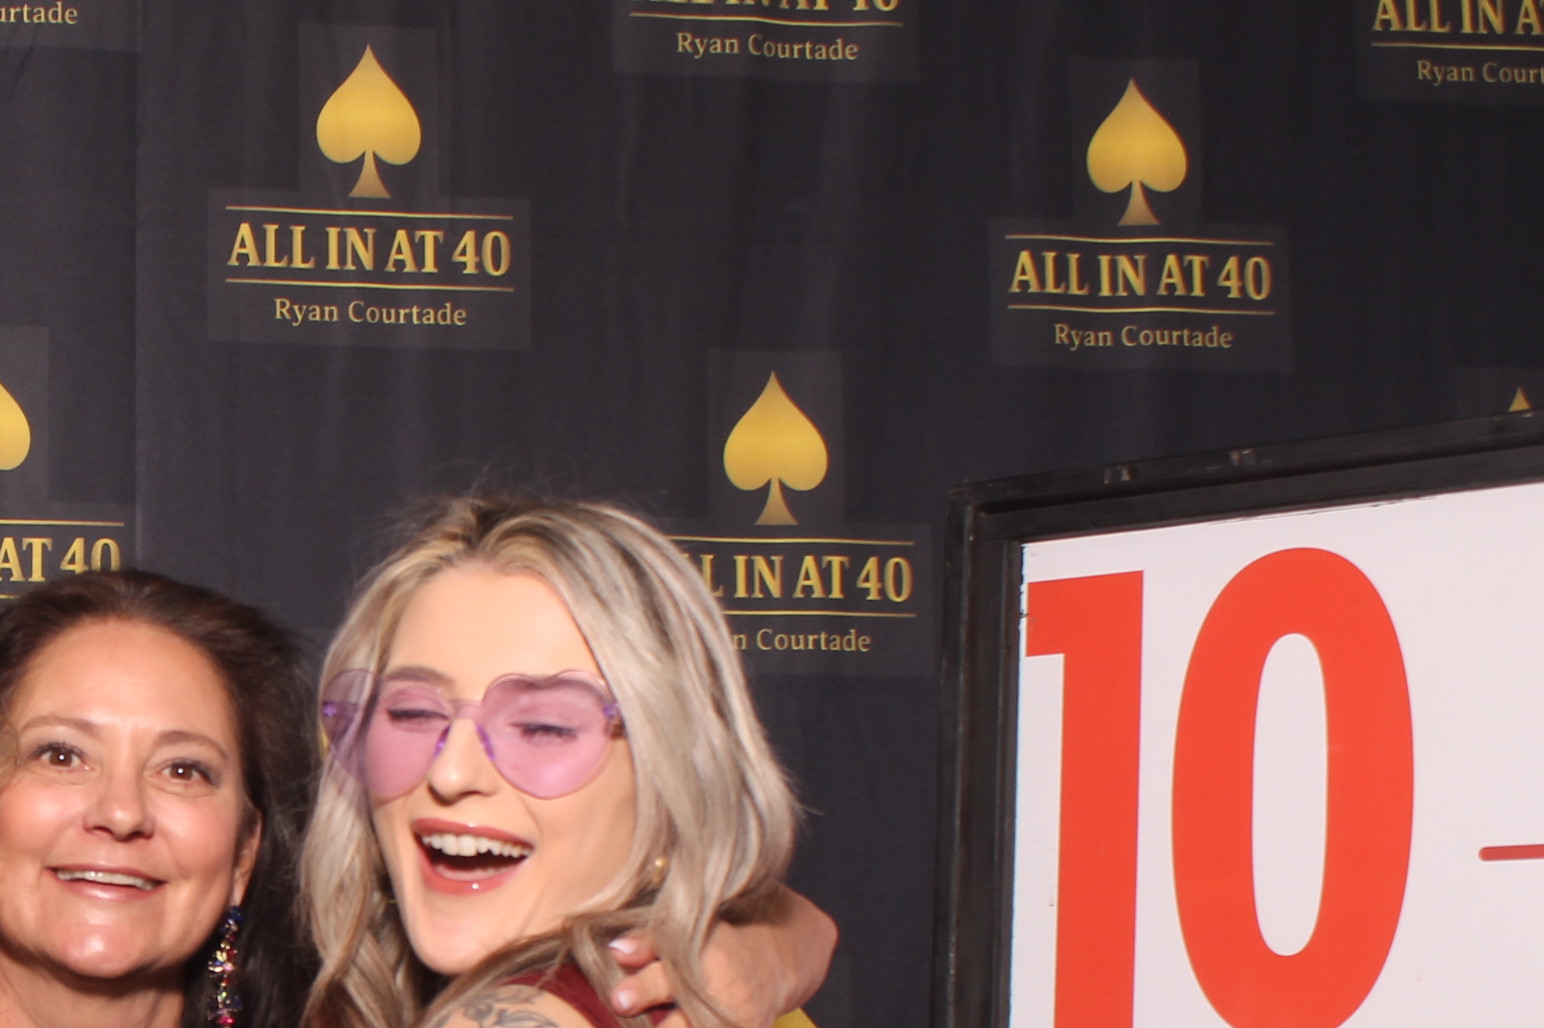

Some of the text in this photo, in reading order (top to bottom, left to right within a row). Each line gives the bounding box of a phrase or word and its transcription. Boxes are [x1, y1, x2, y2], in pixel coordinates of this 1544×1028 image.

[1374, 0, 1544, 36] ALL IN A
[677, 32, 859, 61] Ryan Courtade
[1417, 59, 1544, 87] Ryan Court
[227, 222, 510, 276] ALL IN AT 40
[1009, 250, 1270, 301] ALL IN AT 40
[274, 298, 467, 327] Ryan Courtade
[1054, 323, 1232, 352] Ryan Courtade
[60, 537, 119, 572] 40
[733, 555, 783, 598] IN
[793, 555, 848, 599] AT
[857, 556, 911, 603] 40
[756, 628, 871, 652] Courtade
